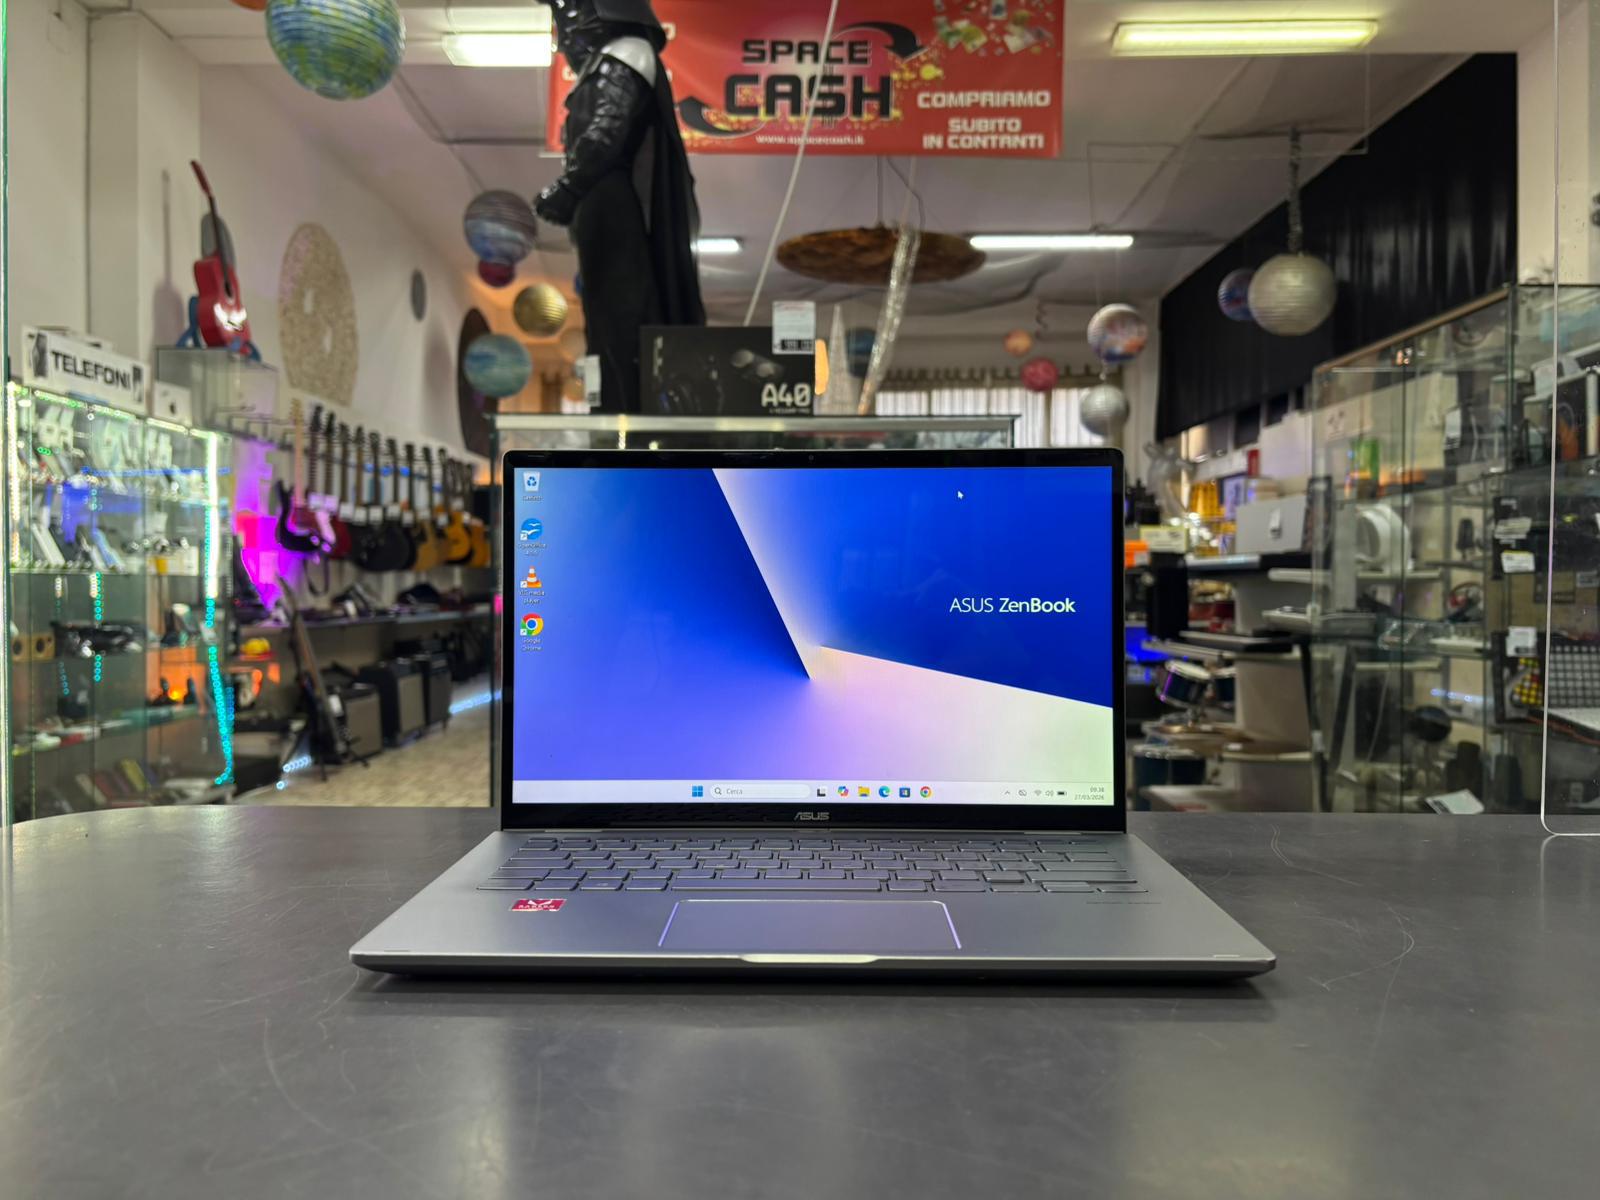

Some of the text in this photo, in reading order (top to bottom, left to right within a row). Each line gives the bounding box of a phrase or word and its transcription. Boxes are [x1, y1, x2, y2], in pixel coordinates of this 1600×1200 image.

[742, 40, 869, 64] SPACE
[725, 74, 892, 117] CASH
[917, 91, 1051, 108] COMPRIAMO
[948, 117, 1022, 132] SUBITO
[922, 133, 1044, 149] IN CONTANTI
[51, 350, 131, 390] TELEFONI
[761, 382, 811, 407] A40
[949, 598, 1076, 613] ASUS ZenBook
[793, 811, 830, 821] ASUS
